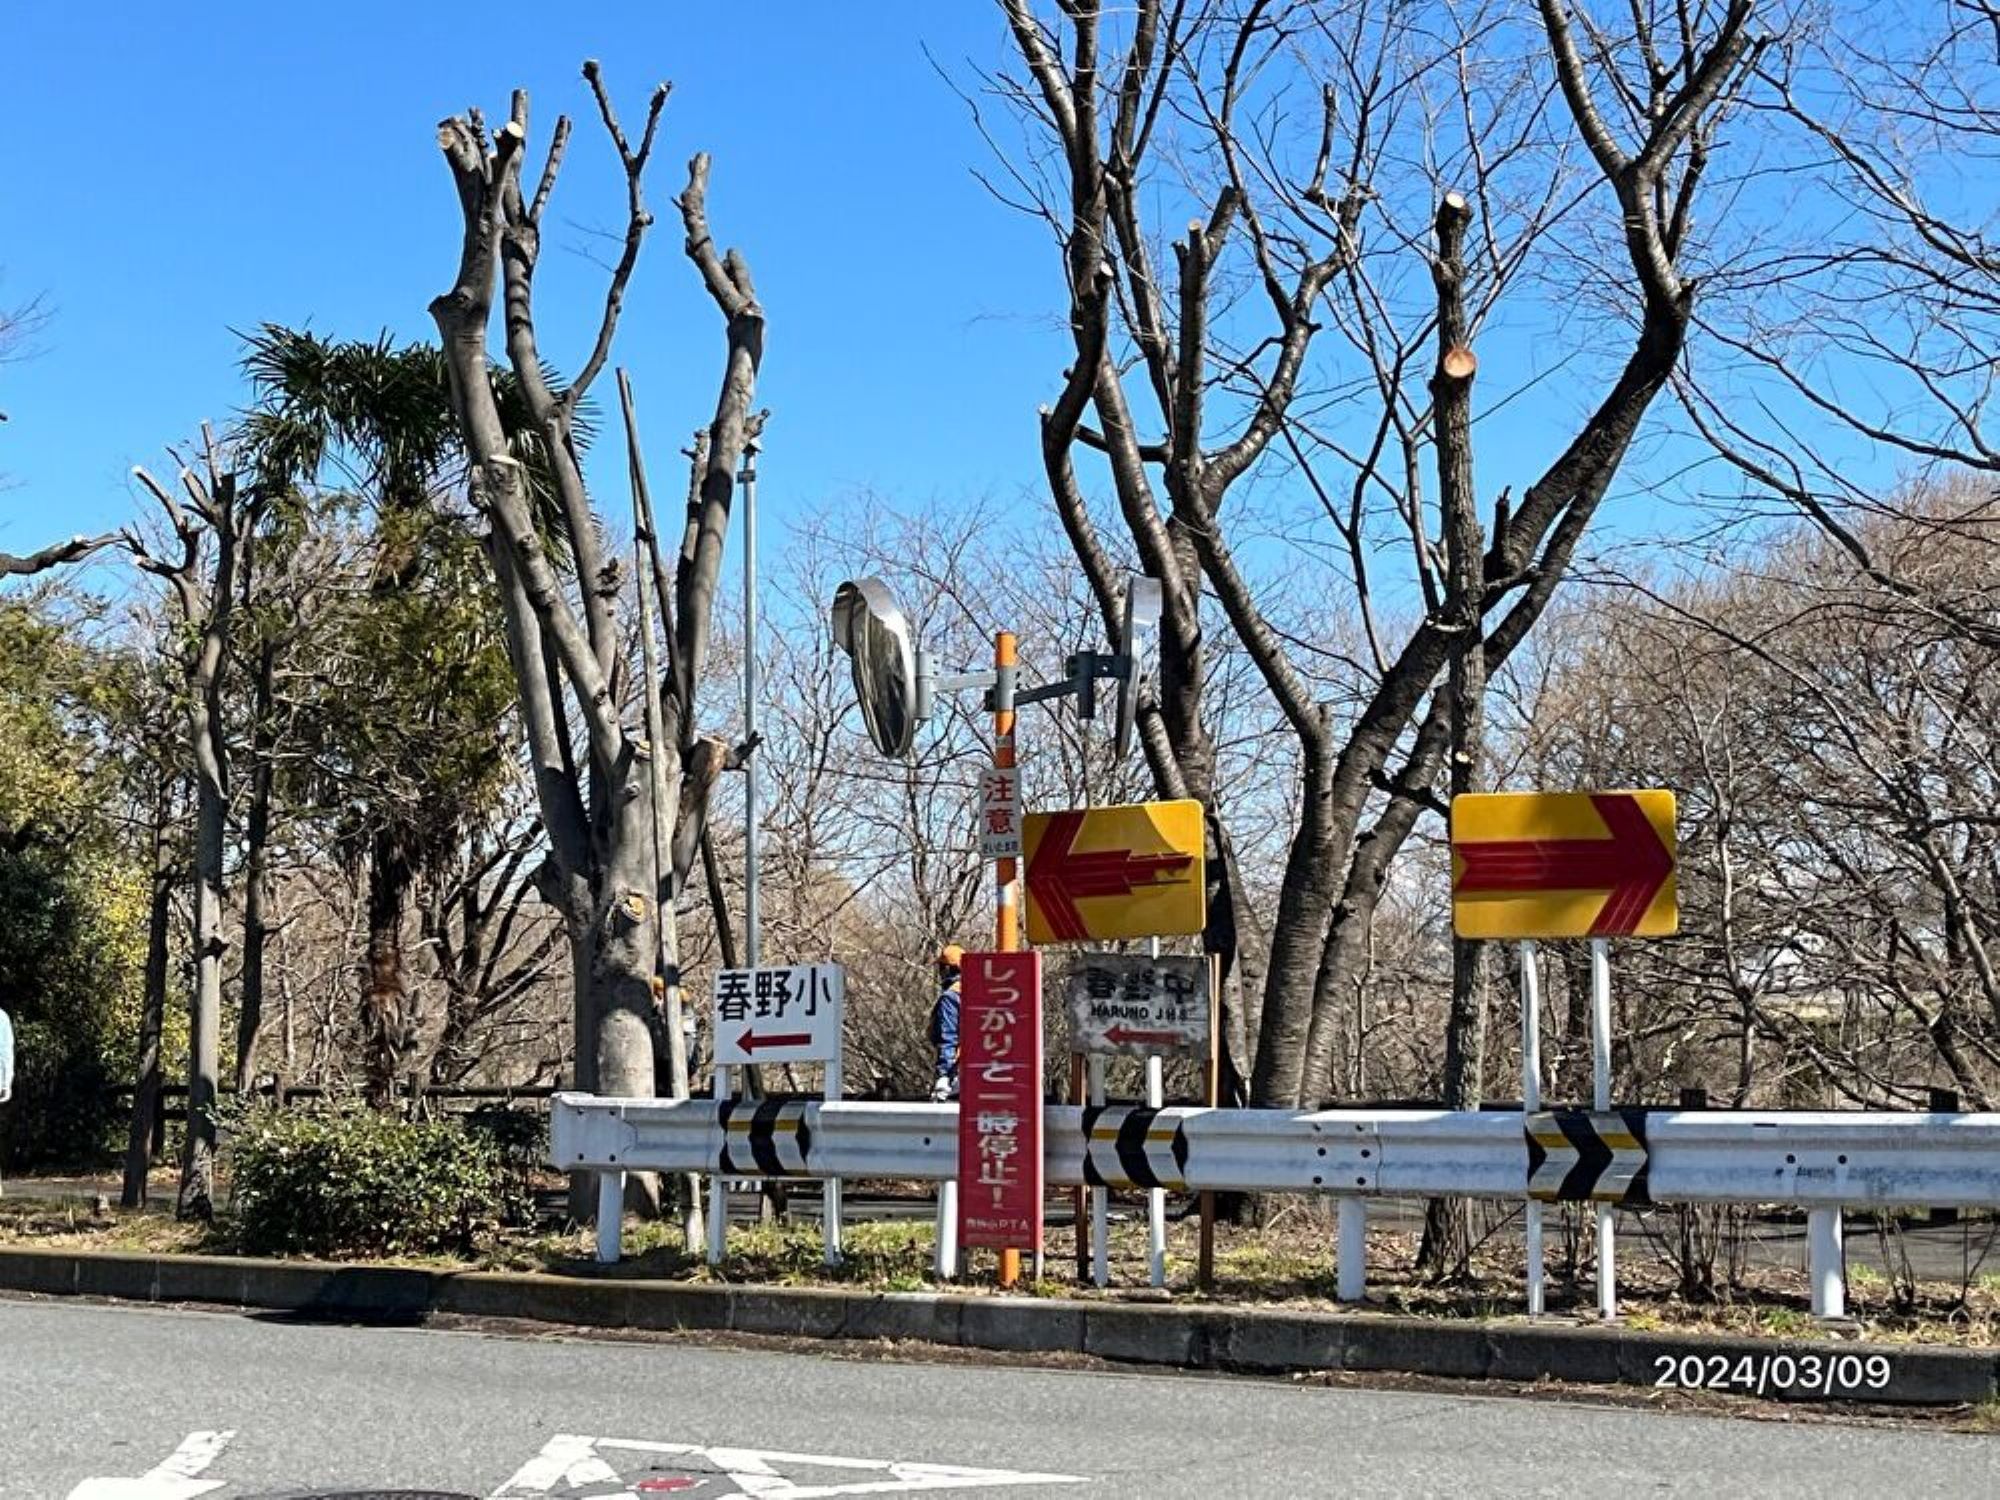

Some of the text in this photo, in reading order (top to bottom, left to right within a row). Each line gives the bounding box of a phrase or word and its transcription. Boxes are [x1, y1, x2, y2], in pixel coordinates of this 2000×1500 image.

[983, 776, 1015, 834] 注意
[717, 967, 832, 1021] 春野小
[1091, 1004, 1149, 1019] HARUNO
